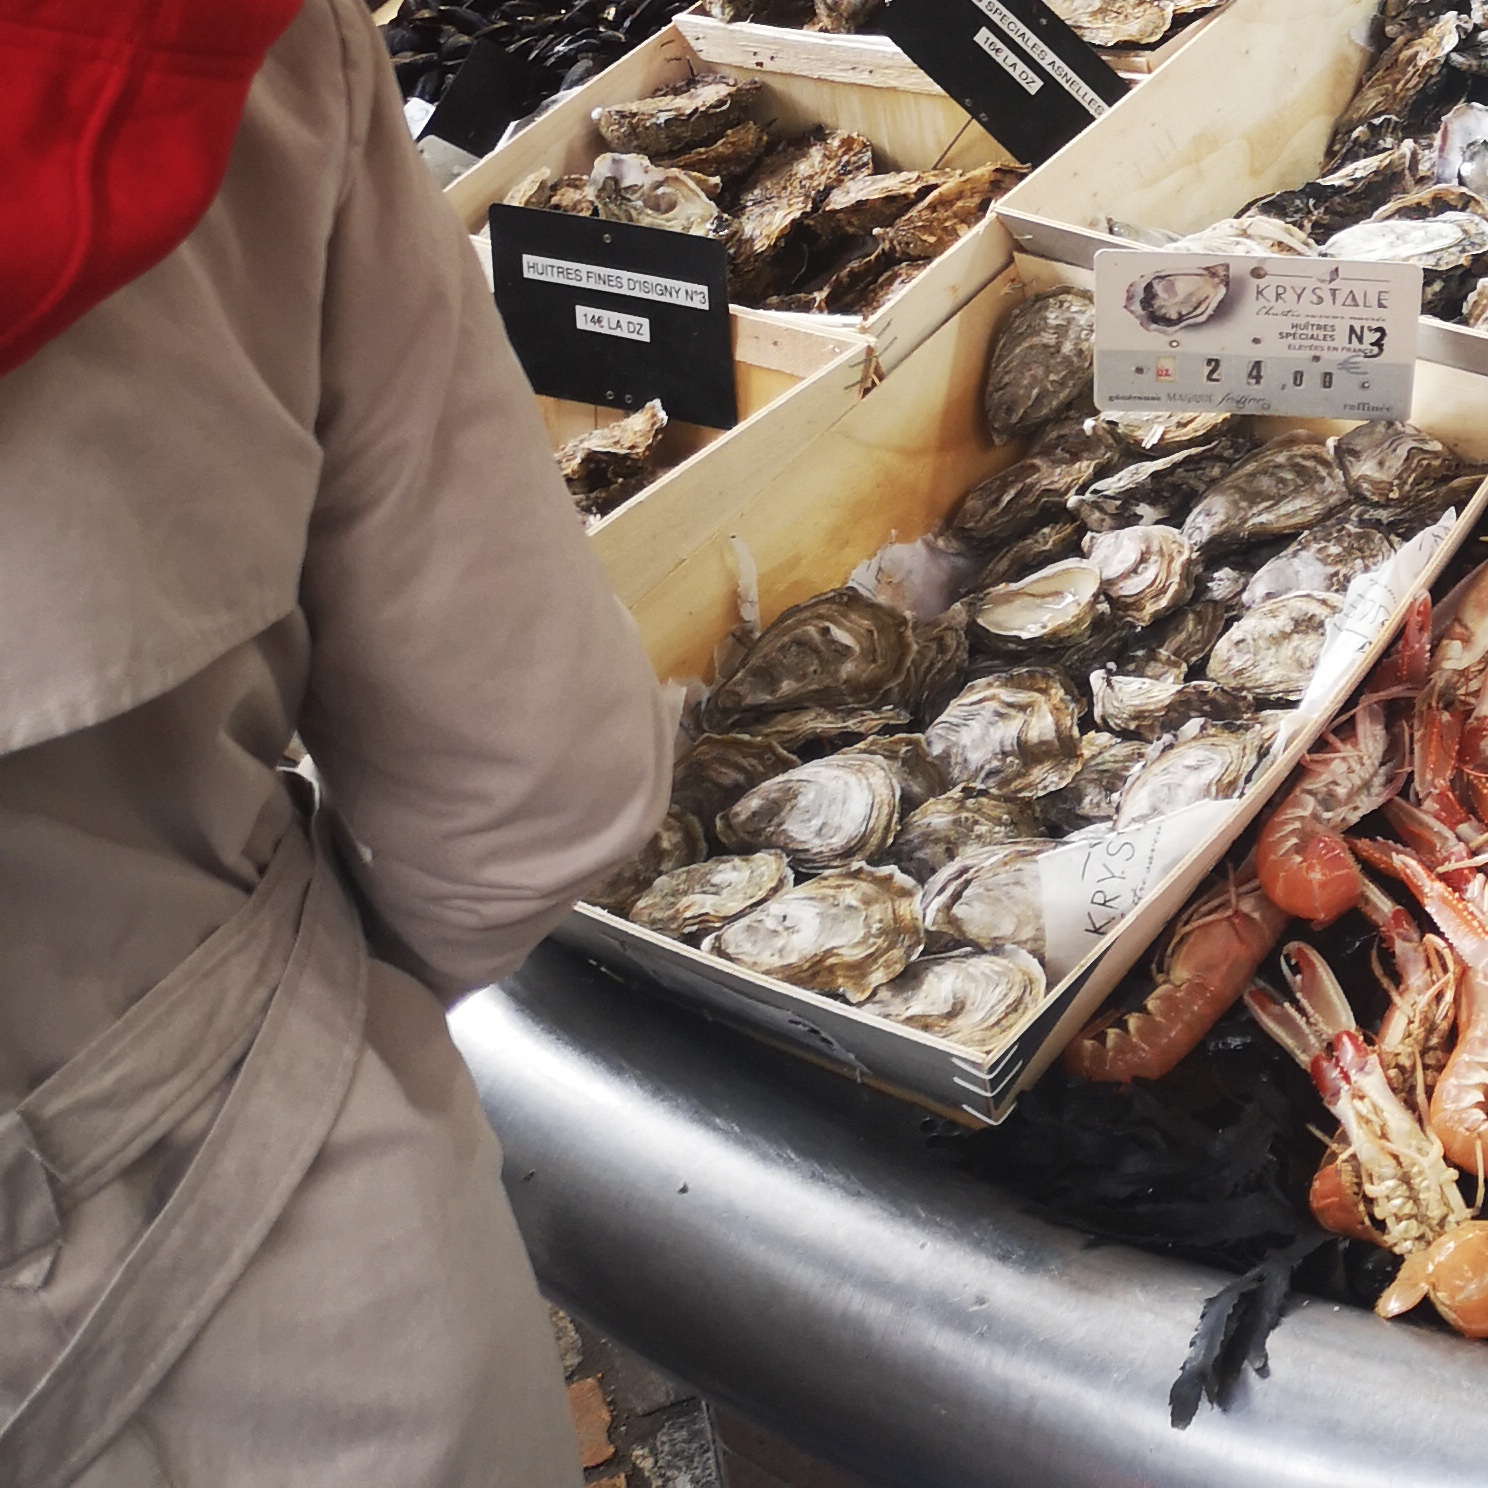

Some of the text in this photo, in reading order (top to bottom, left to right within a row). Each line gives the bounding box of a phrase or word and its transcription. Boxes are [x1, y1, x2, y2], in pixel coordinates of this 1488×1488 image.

[983, 36, 1037, 89] 16€ LA DZ
[985, 1, 1049, 62] SPECIALES
[1048, 59, 1105, 116] ASNELLES
[526, 261, 707, 305] HUITRES FINES D'ISIGNY N°3
[1255, 284, 1390, 309] KRYSTALE
[583, 312, 644, 336] 14€ LA DZ
[1290, 321, 1337, 332] HUÎTRES
